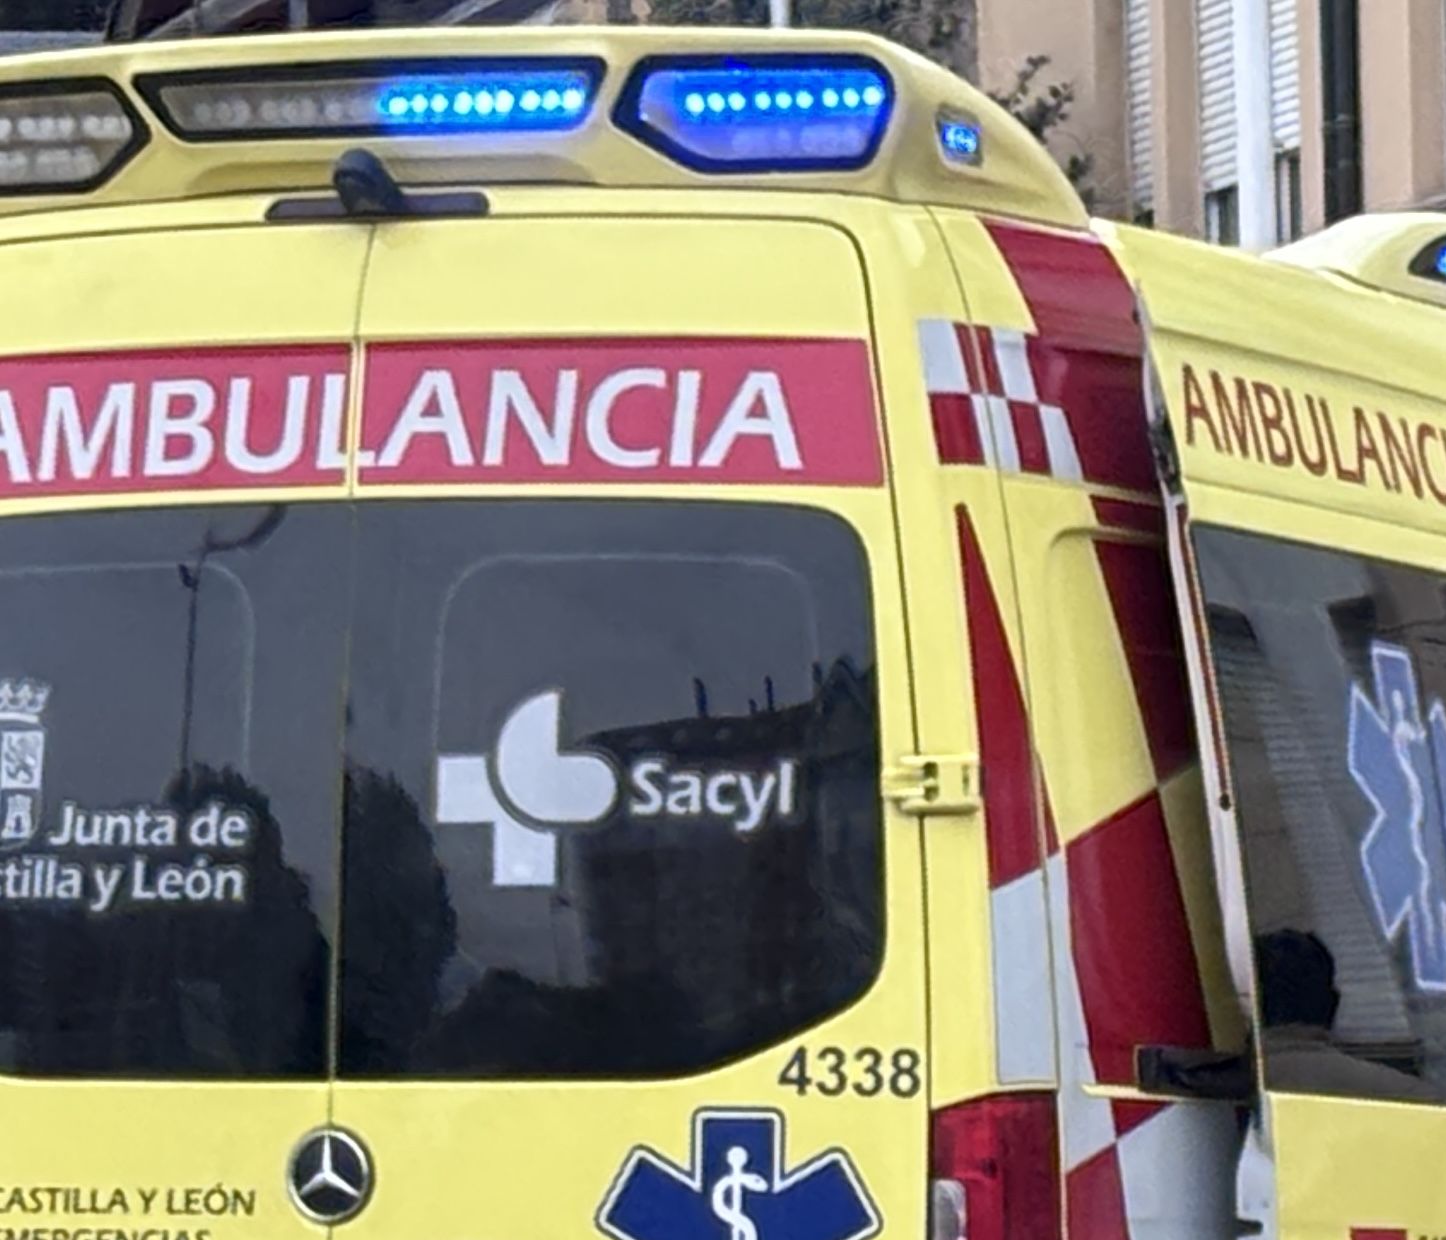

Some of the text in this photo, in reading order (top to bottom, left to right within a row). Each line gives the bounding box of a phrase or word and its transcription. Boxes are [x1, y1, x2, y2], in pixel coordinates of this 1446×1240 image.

[631, 760, 794, 832] Sacyl
[50, 803, 248, 846] Junta de
[0, 853, 244, 912] tilla y León
[778, 1045, 921, 1098] 4338
[138, 1187, 157, 1215] Y
[165, 1182, 256, 1216] LEÓN
